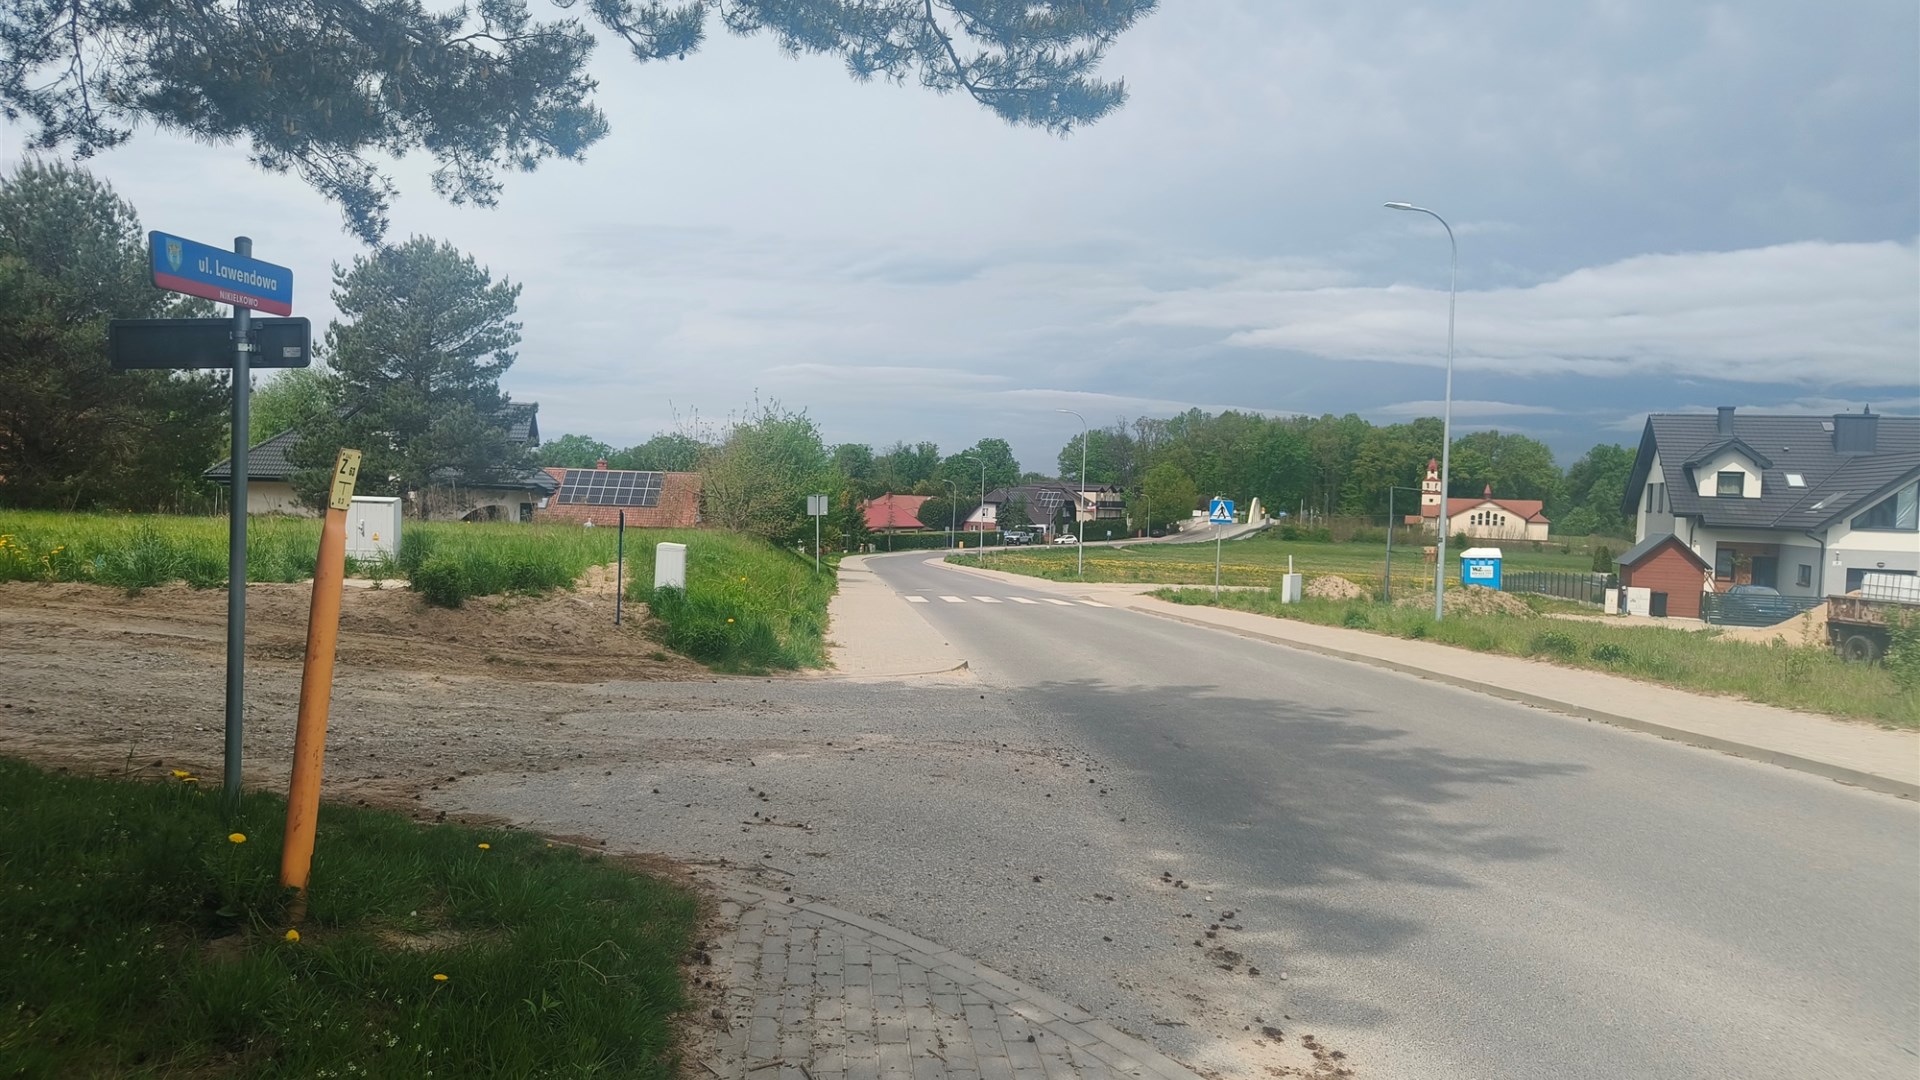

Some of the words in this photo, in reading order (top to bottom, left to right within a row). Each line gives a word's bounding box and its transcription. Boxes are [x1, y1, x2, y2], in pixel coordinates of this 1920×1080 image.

[198, 256, 213, 275] ul.
[215, 259, 277, 291] Lawendowa
[219, 290, 259, 307] NIKIELKOWO
